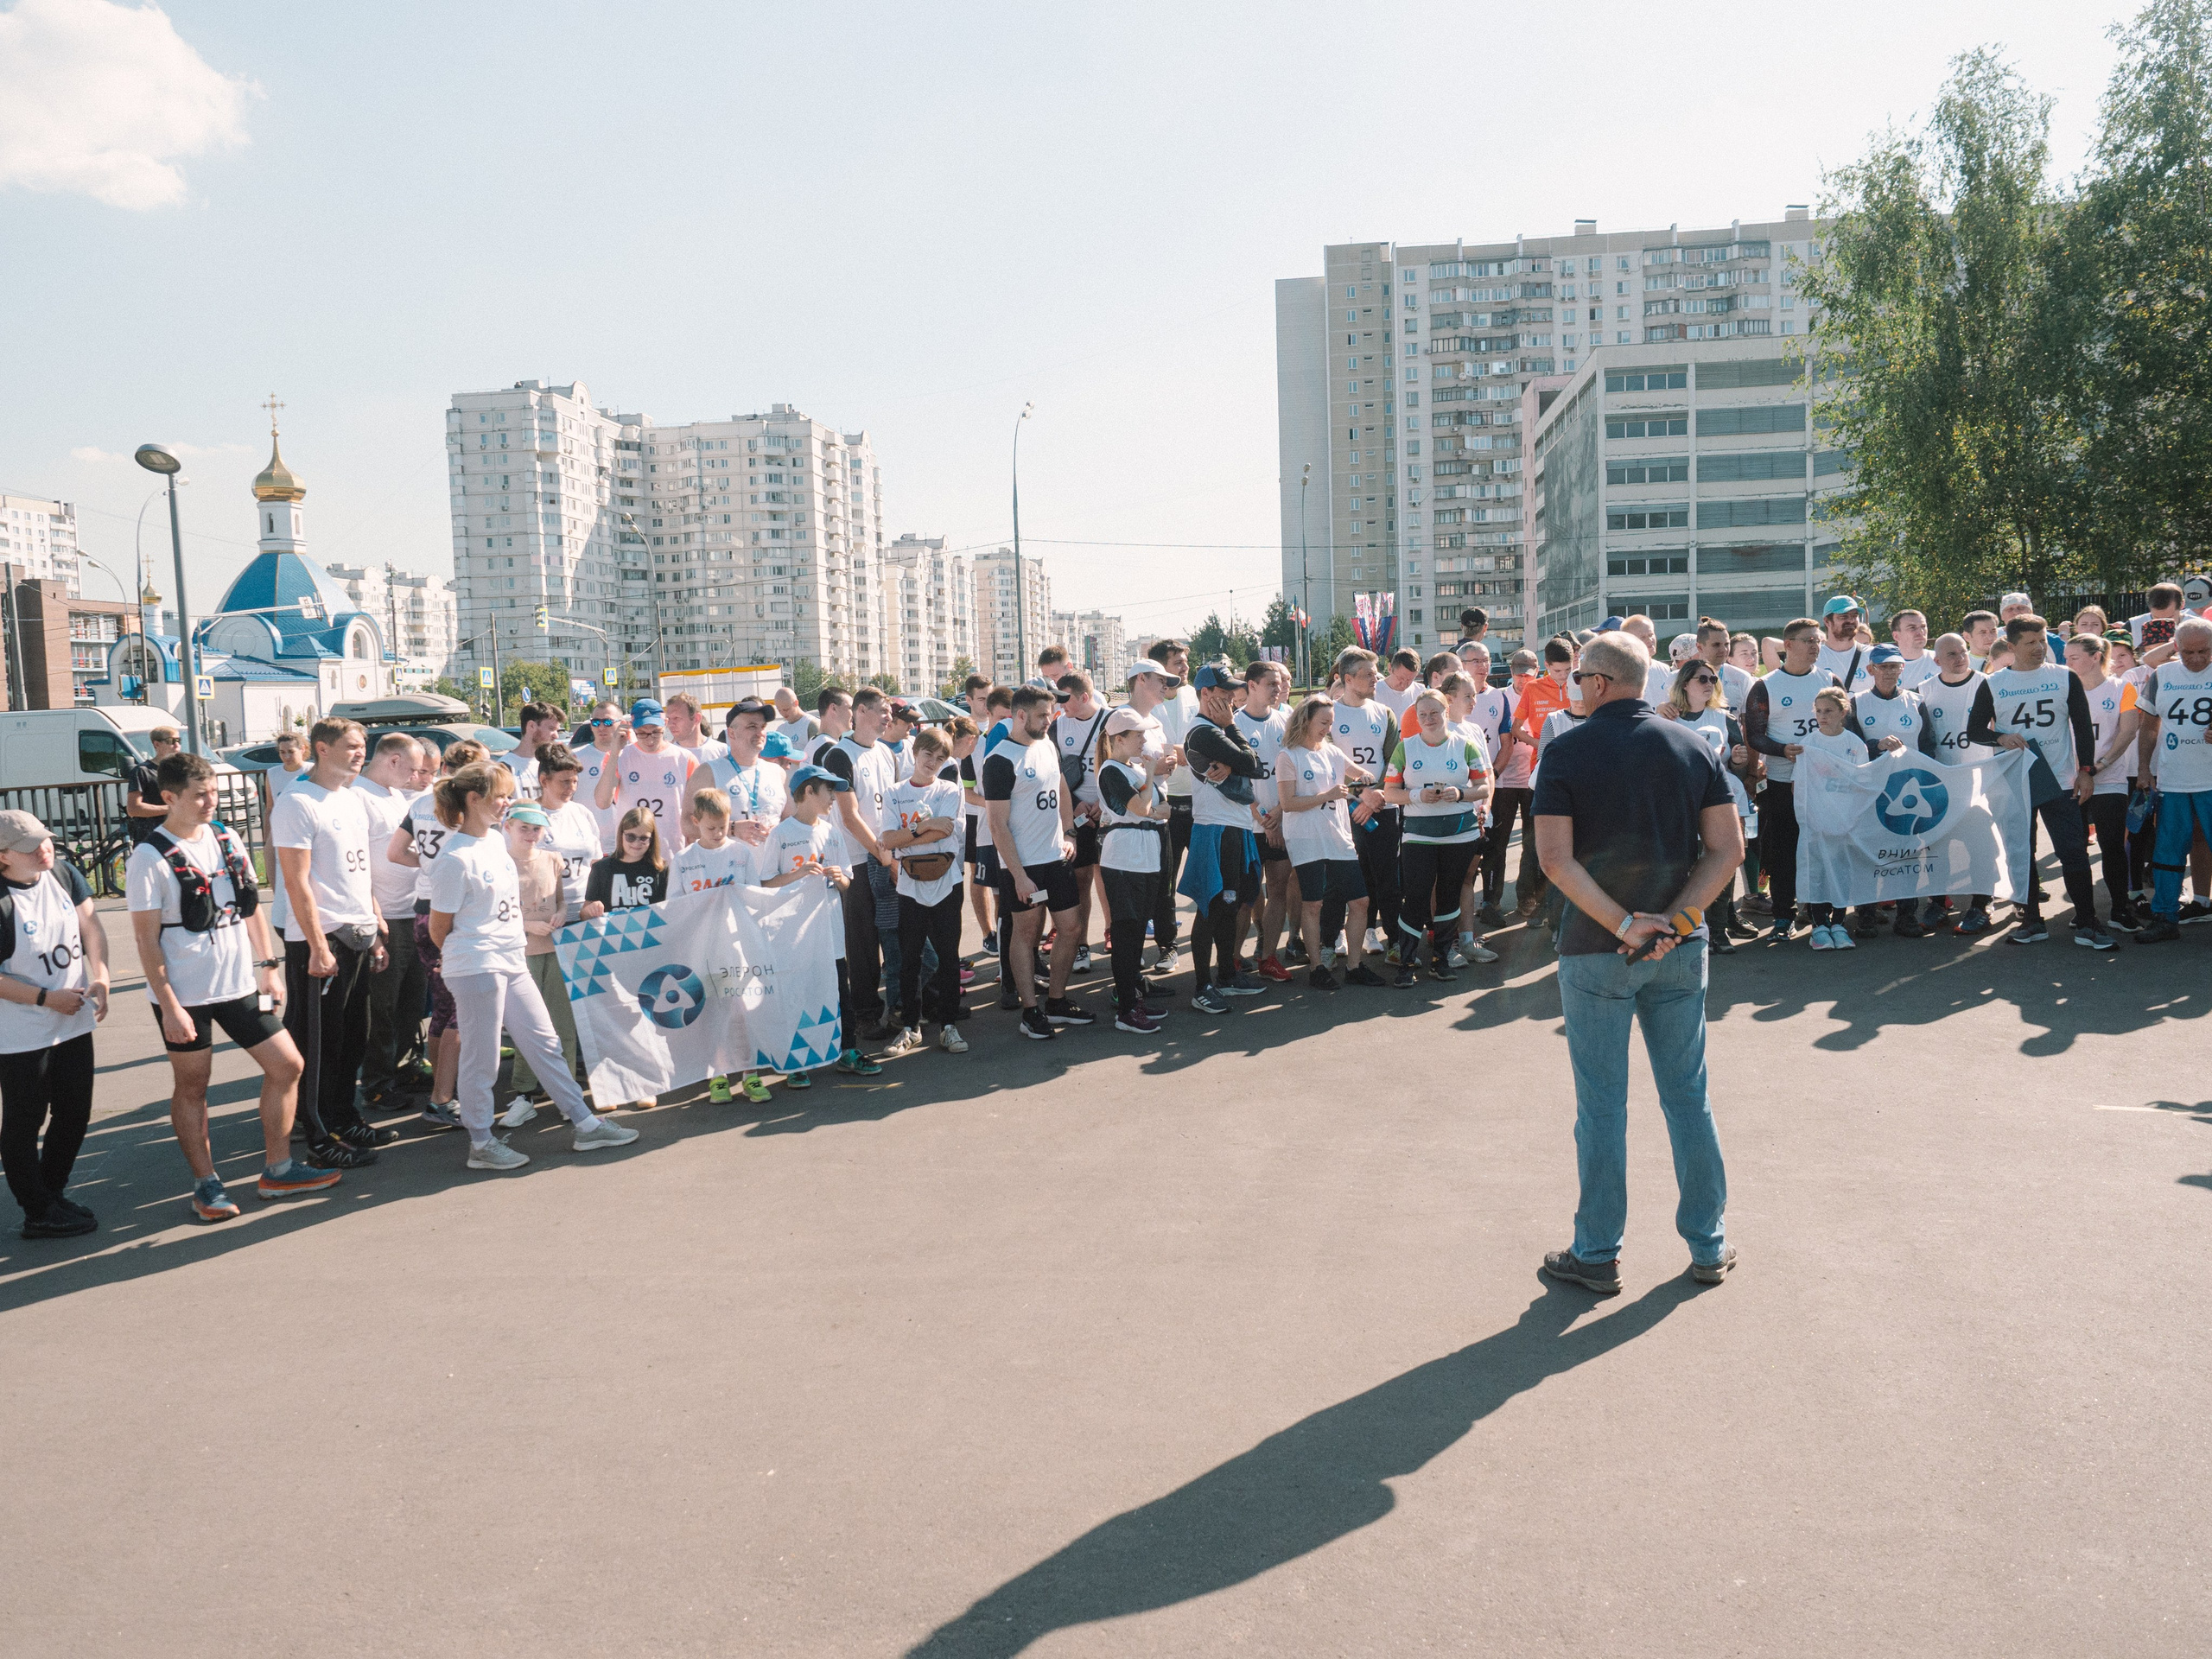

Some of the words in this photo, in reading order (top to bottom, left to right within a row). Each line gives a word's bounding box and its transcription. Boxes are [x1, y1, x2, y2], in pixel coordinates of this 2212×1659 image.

[2041, 683, 2060, 692] 22
[2011, 698, 2056, 729] 45
[2167, 696, 2212, 726] 48
[1793, 718, 1820, 737] 38
[1940, 731, 1971, 750] 46
[2039, 738, 2060, 747] САТОМ
[1352, 747, 1376, 765] 52
[1036, 789, 1058, 810] 68
[416, 829, 445, 860] 83
[1873, 863, 1934, 879] РОСАТОМ
[719, 963, 775, 979] ЭЛЕРОН
[724, 985, 774, 997] РОСАТОМ
